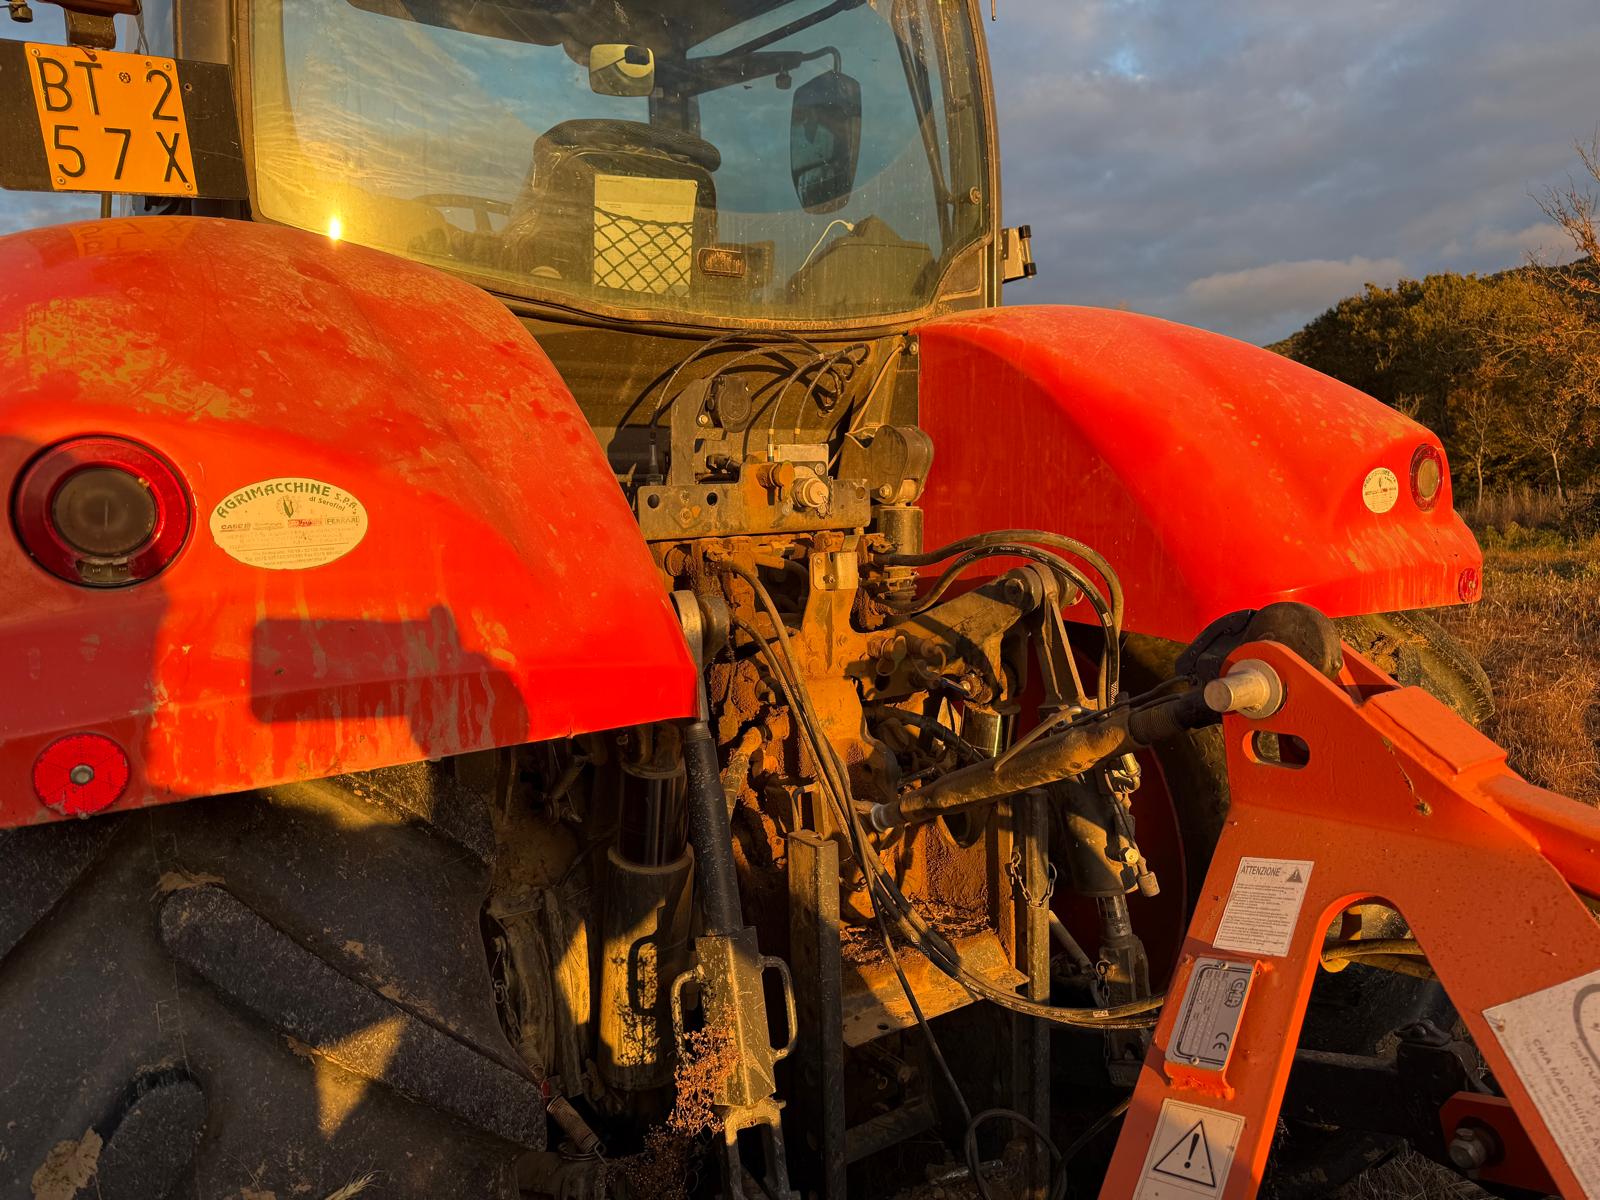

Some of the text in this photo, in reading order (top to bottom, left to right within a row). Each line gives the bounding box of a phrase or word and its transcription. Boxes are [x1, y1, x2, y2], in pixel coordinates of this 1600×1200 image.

[37, 57, 179, 122] BT 2
[216, 482, 332, 519] AGRIMACCHINE
[1240, 865, 1282, 877] ATTENZIONE
[1533, 1039, 1552, 1065] CMA
[1549, 1067, 1594, 1133] MACCHINE
